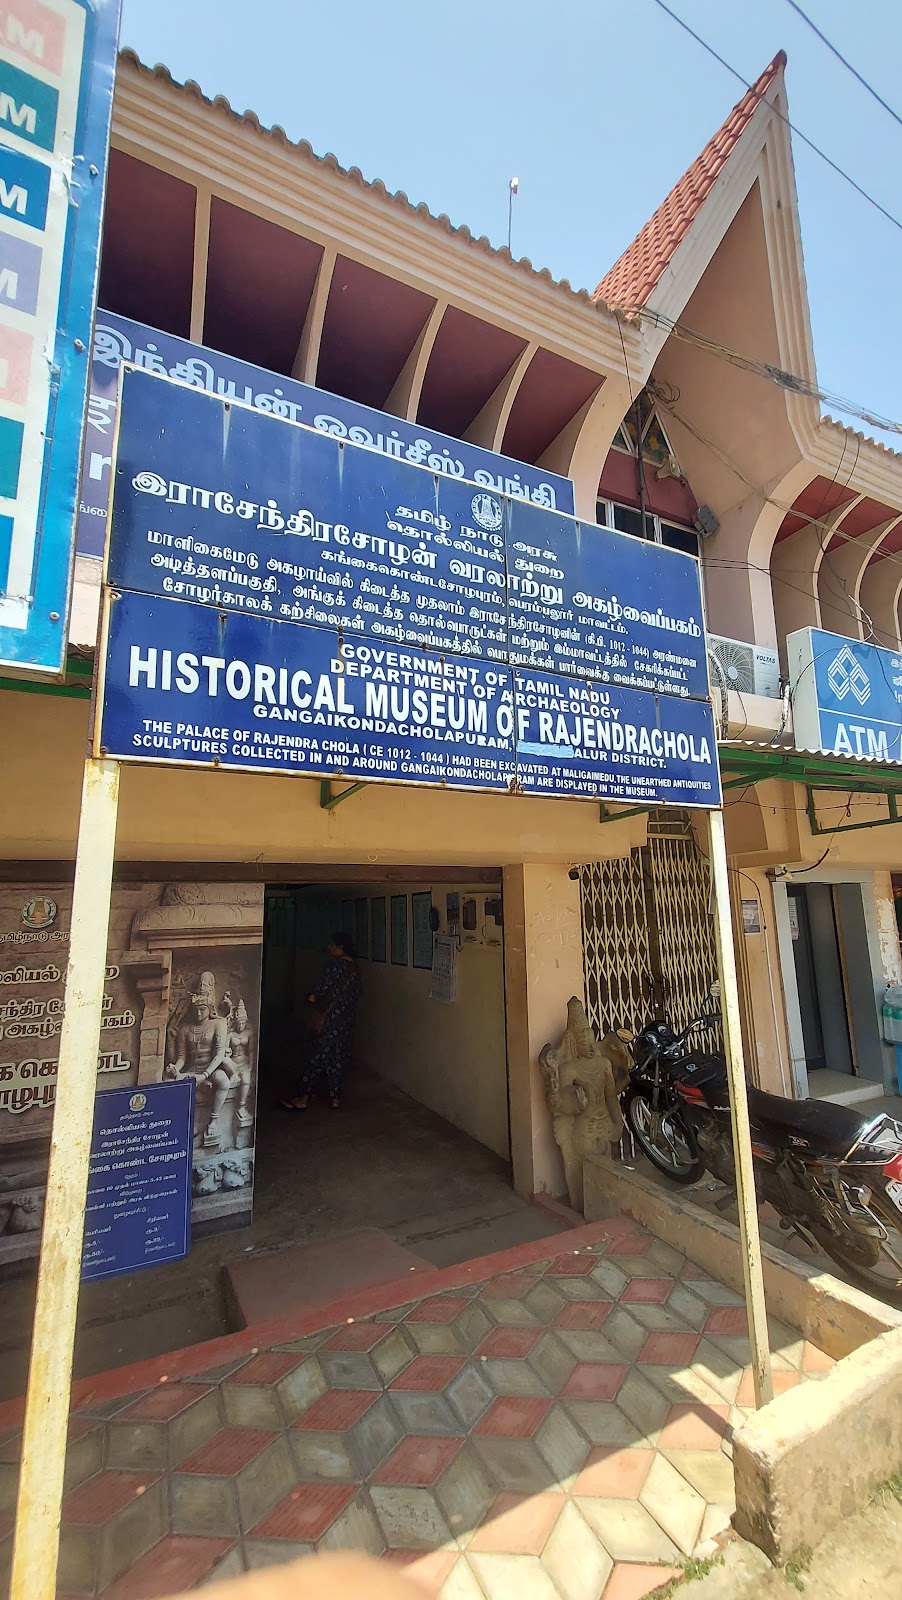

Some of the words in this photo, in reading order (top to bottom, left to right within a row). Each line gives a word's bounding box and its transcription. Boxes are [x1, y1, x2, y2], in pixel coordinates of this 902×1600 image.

[131, 471, 438, 569] இராசேந்திரசோழன்
[449, 558, 564, 605] வரலாற்று
[572, 591, 701, 638] அகழ்வைப்பகம்
[387, 520, 505, 563] தொல்லியல்
[514, 557, 565, 580] துறை
[394, 505, 452, 532] தமிழ்
[459, 525, 504, 547] நாடு
[512, 541, 558, 562] அரசு
[147, 530, 259, 570] மாளிகைமேடு
[266, 558, 354, 589] அகழாய்வில்
[360, 577, 411, 604] கிடைத்த
[415, 594, 466, 616] முதலாம்
[609, 639, 626, 652] 1012
[632, 644, 650, 660] 1044)
[652, 650, 697, 668] அரண்மனை
[150, 553, 281, 595] அடித்தளப்பகுதி,
[292, 584, 347, 607] அங்குக்
[352, 595, 405, 621] கிடைத்த
[409, 611, 508, 643] தொல்பொருட்கள்
[511, 632, 550, 652] மற்றும்
[162, 576, 273, 612] சோழர்காலக்
[280, 600, 365, 631] கற்சிலைகள்
[371, 621, 483, 655] அகழ்வைப்பகத்தில்
[321, 550, 505, 608] கங்கைகொண்டசோழபுரம்,
[578, 615, 629, 635] மாவட்டம்.
[330, 658, 468, 695] DEPARTMENT
[473, 684, 496, 700] OF
[500, 689, 622, 720] ARCHAEOLOGY
[340, 643, 480, 682] GOVERNMENT
[485, 671, 508, 687] OF
[515, 677, 565, 699] TAMIL
[568, 686, 611, 706] NADU
[756, 654, 776, 664] VOLTAS
[129, 645, 355, 714] HISTORICAL
[365, 681, 488, 733] MUSEUM
[496, 704, 531, 740] OF
[539, 711, 712, 765] RAJENDRACHOLA
[132, 733, 227, 754] SCULPTURES
[232, 743, 306, 763] COLLECTED
[309, 749, 323, 764] IN
[325, 751, 350, 767] AND
[352, 757, 398, 771] AROUND
[536, 777, 554, 788] ARE
[555, 779, 597, 792] DISPLAYED
[599, 783, 607, 793] IN
[609, 785, 625, 794] THE
[625, 786, 658, 797] MUSEUM.
[143, 719, 172, 735] THE
[176, 723, 229, 741] PALACE
[233, 728, 250, 743] OF
[253, 731, 319, 750] RAJENDRA
[321, 738, 361, 755] CHOLA
[369, 745, 384, 757] CE
[387, 747, 411, 760] 1012
[420, 751, 443, 763] 1044
[452, 755, 472, 767] HAD
[473, 757, 497, 770] BEEN
[498, 760, 549, 775] EXCAVATED
[551, 766, 562, 777] AT
[631, 776, 672, 788] UNEARTHED
[672, 779, 712, 790] ANTIQUITIES
[611, 751, 667, 769] DISTRICT.
[834, 722, 889, 759] ATM
[50, 930, 71, 942] அர
